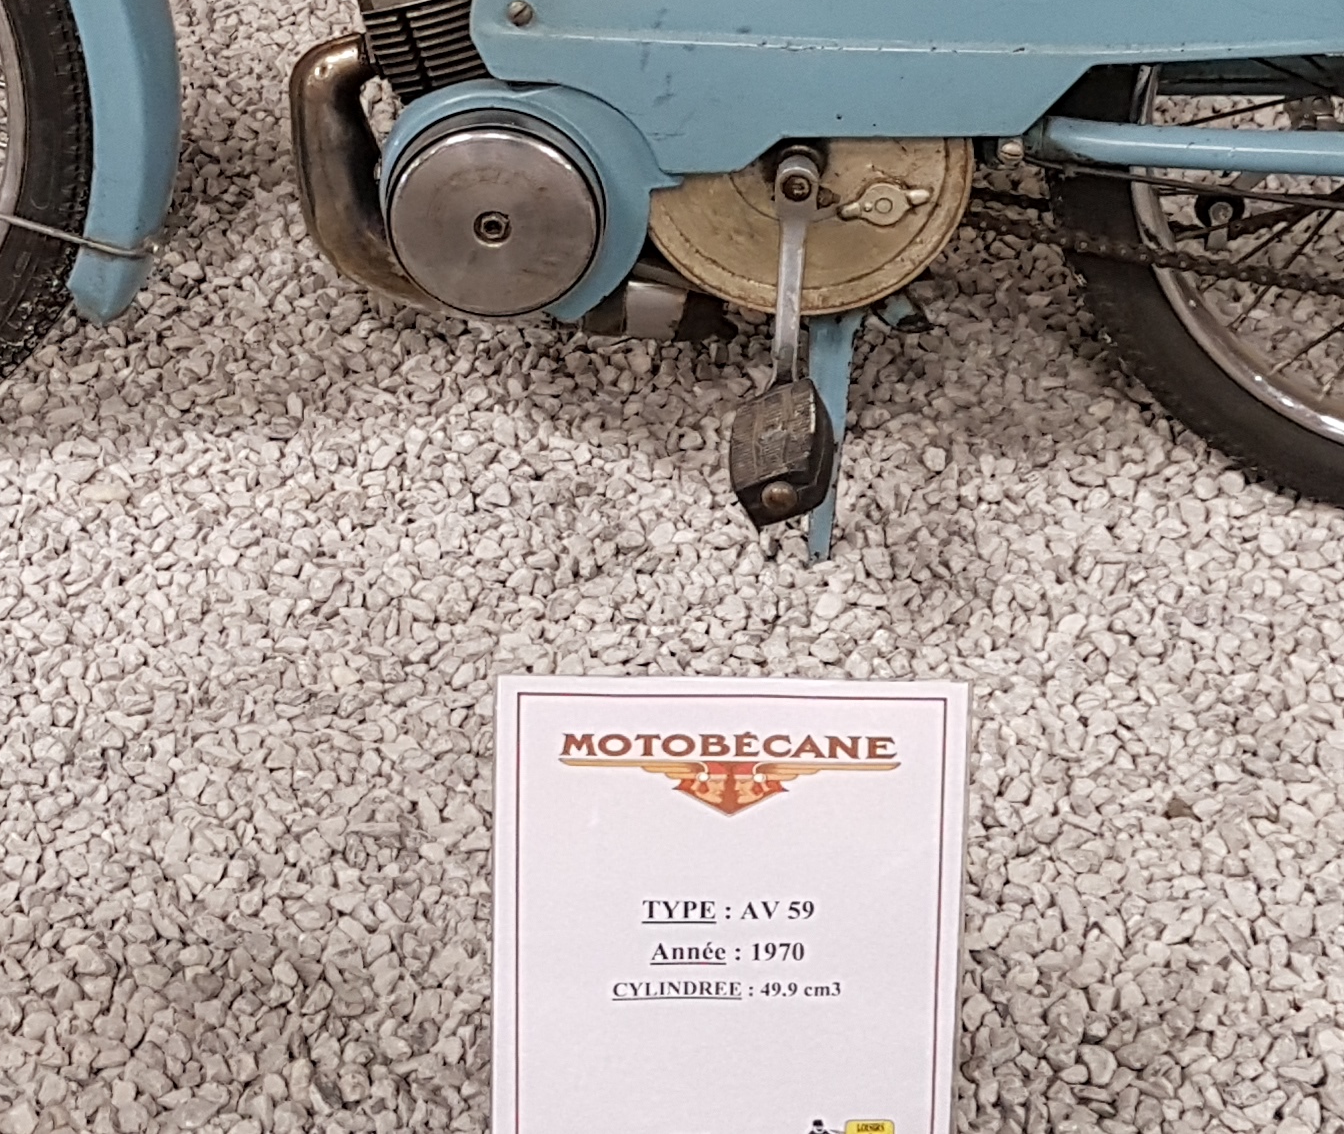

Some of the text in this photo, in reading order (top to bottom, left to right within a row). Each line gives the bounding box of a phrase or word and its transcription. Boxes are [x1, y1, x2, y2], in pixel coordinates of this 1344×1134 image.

[559, 730, 898, 759] MOTOBÉCANE
[642, 900, 717, 921] TYPE
[741, 900, 781, 920] AV
[787, 900, 815, 920] 59
[651, 942, 726, 962] Année
[752, 942, 805, 962] 1970
[612, 981, 742, 998] CYLINDREE
[760, 981, 799, 997] 49.9
[804, 981, 841, 997] cm3
